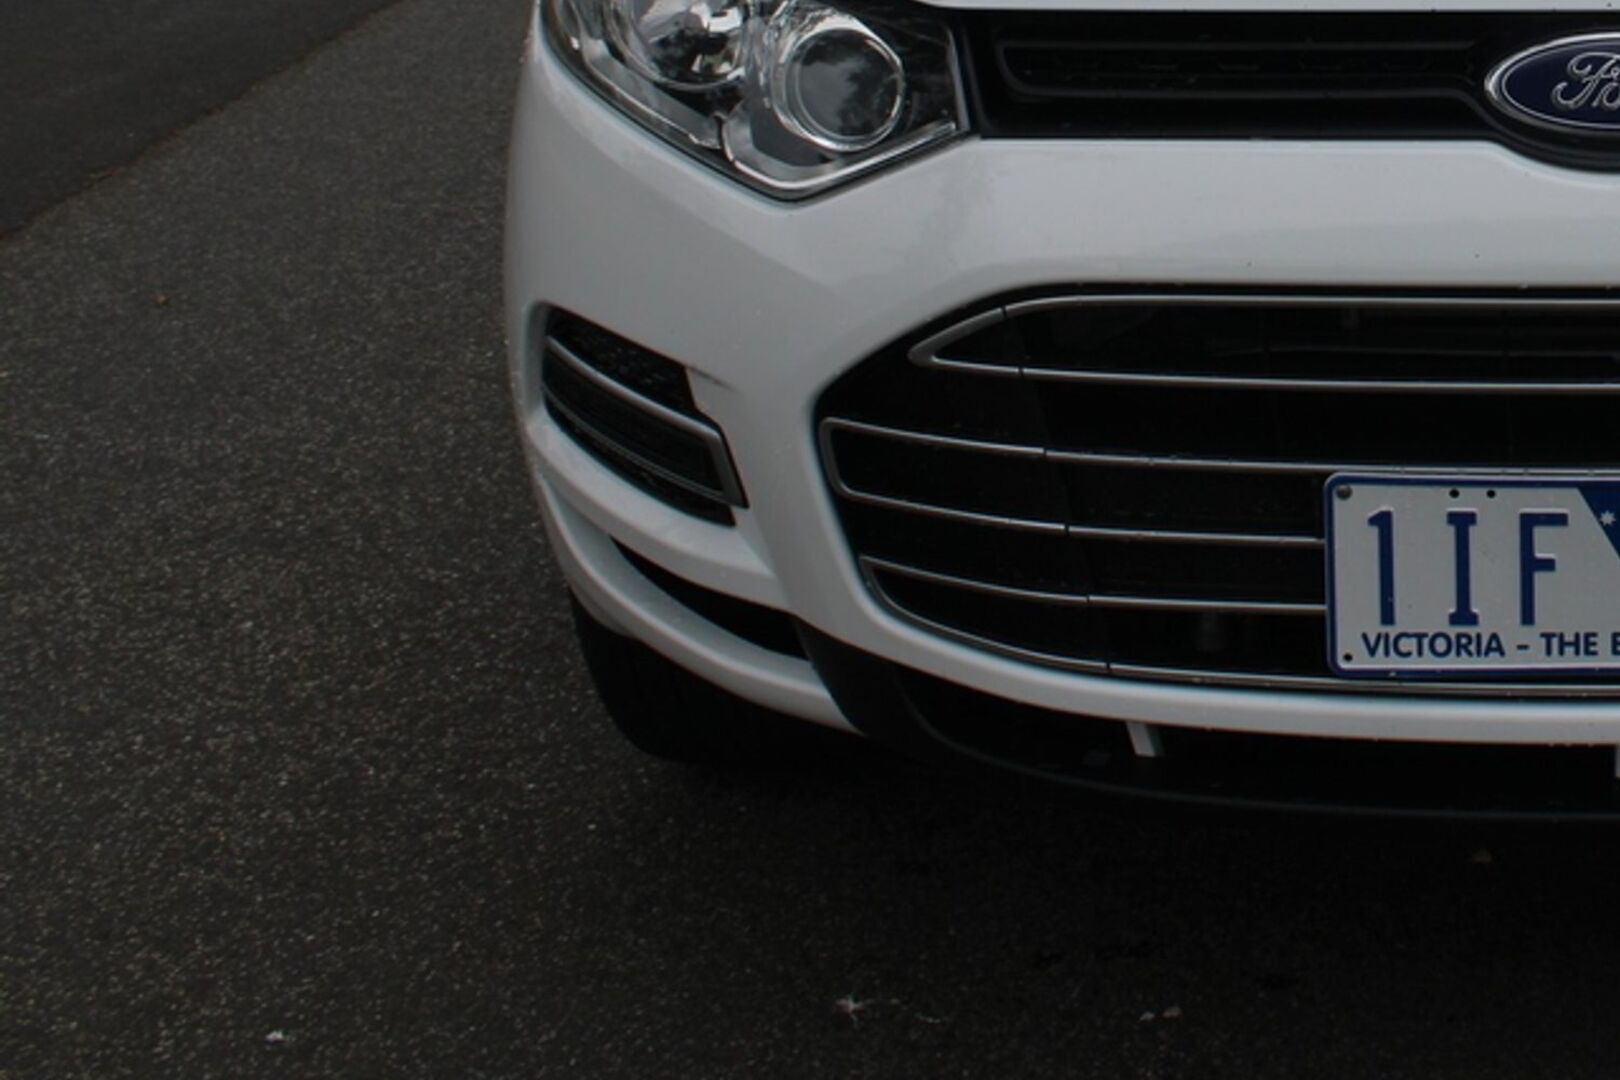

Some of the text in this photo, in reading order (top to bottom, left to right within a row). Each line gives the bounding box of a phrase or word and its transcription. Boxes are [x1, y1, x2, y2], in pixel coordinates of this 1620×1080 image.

[1366, 507, 1570, 626] 1IF
[1361, 631, 1505, 658] VICTORIA
[1540, 631, 1598, 657] THE
